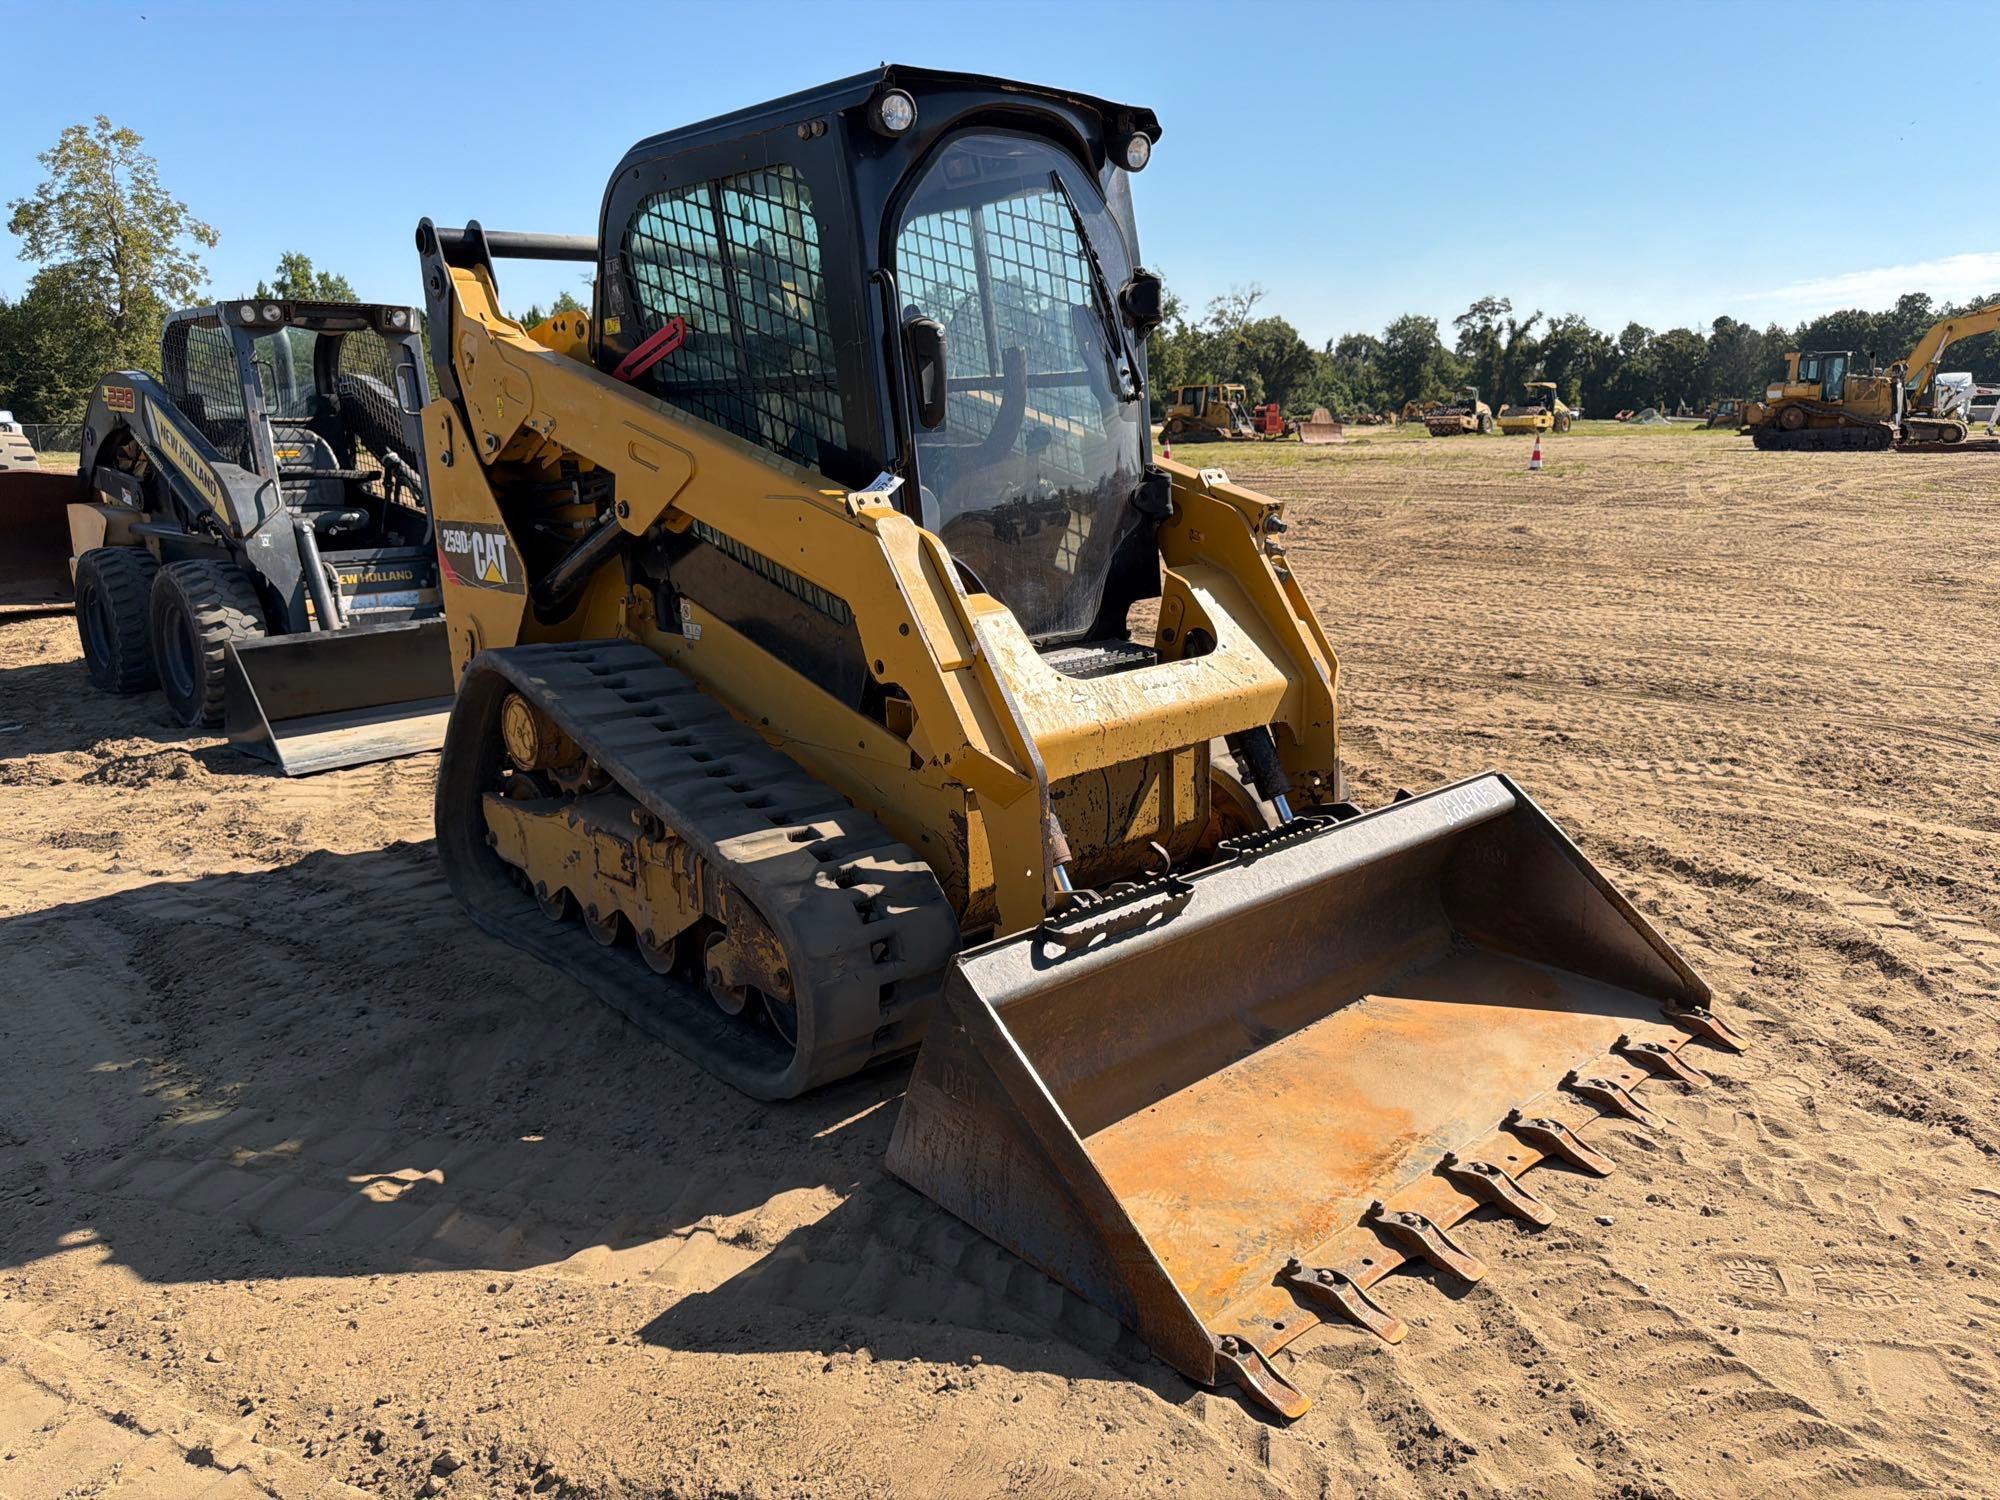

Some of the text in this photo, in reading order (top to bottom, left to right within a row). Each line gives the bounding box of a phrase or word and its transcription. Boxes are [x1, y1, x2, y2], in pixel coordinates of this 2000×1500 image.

[102, 386, 135, 411] L228
[160, 422, 216, 497] NEW HOLLAND
[339, 570, 413, 584] EW HOLLAND
[472, 532, 508, 584] CAT
